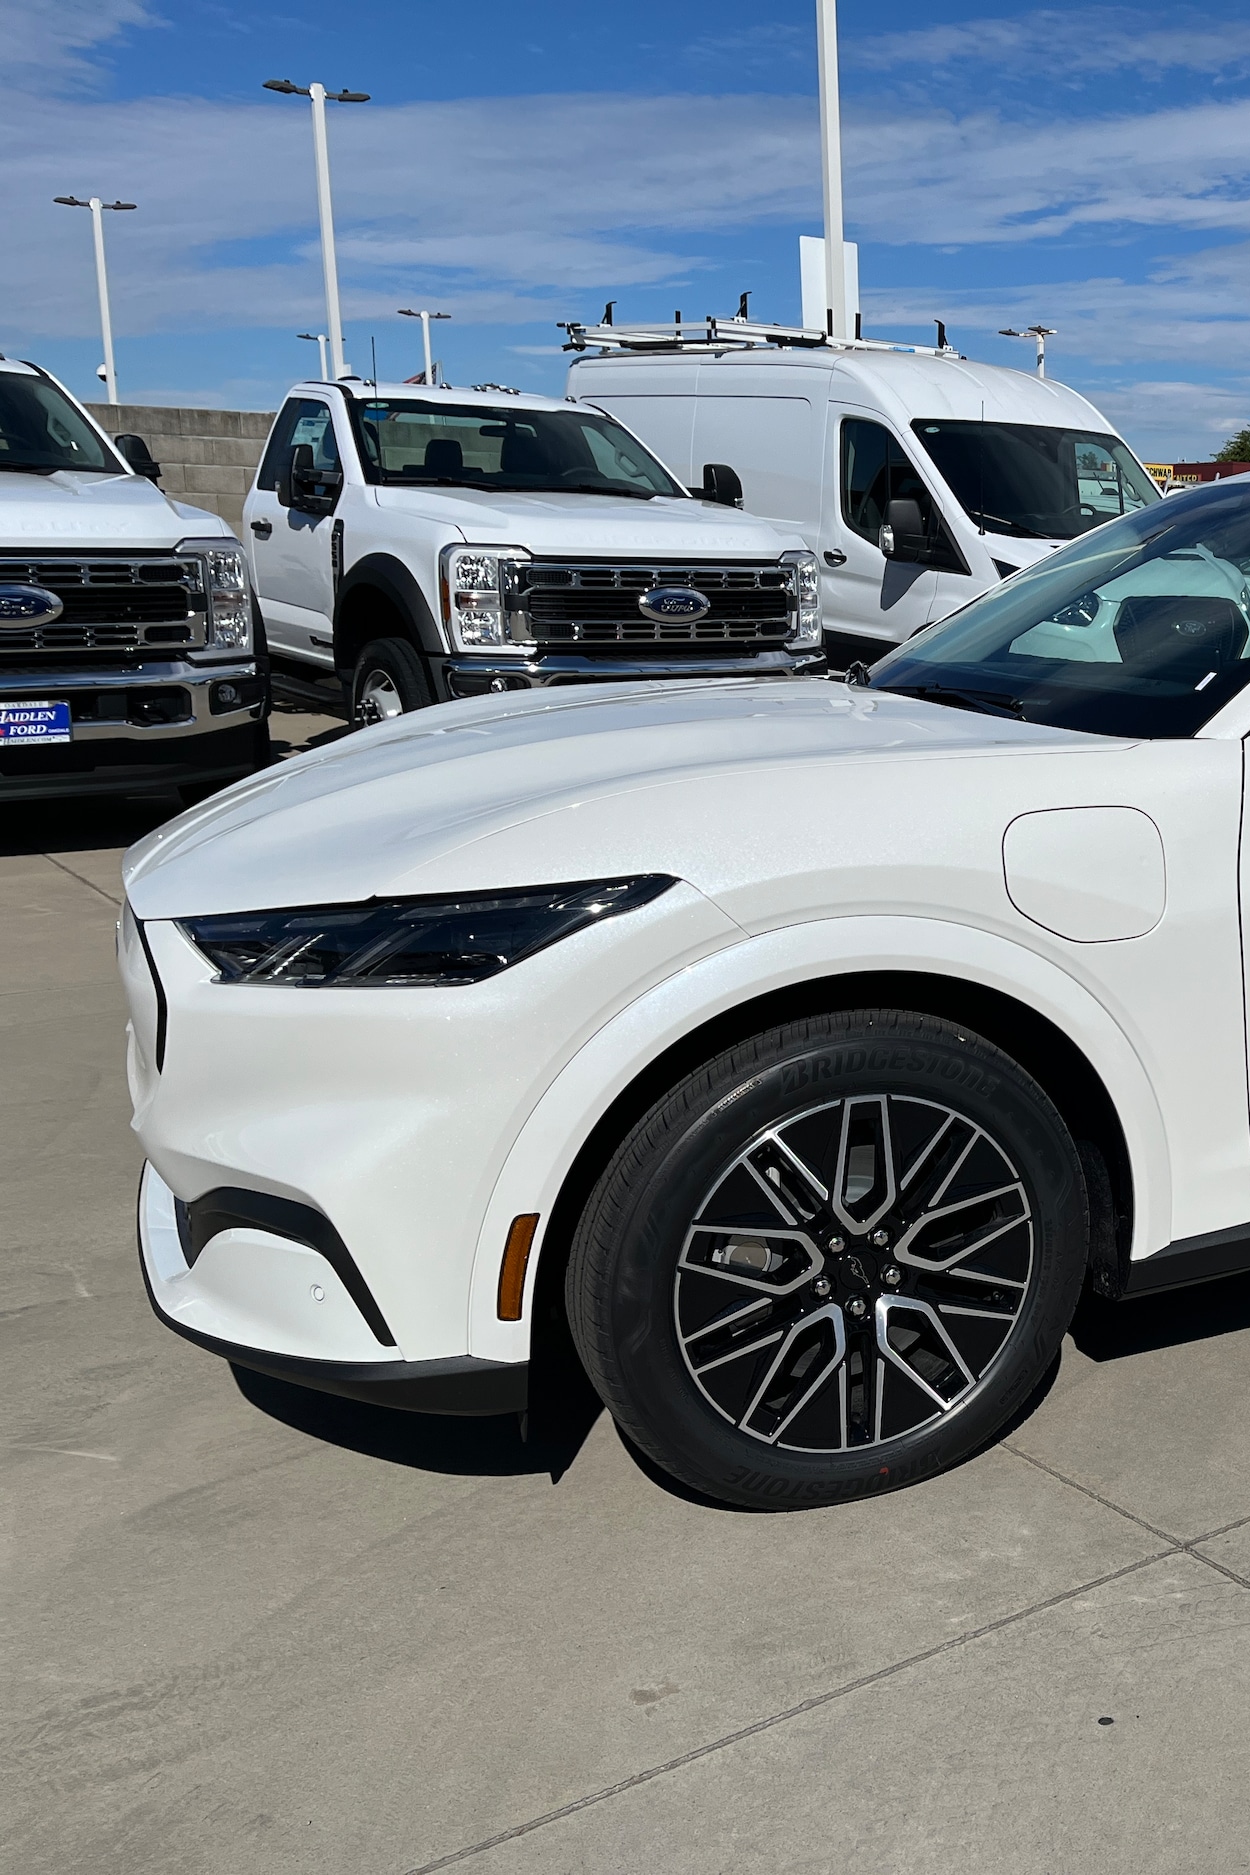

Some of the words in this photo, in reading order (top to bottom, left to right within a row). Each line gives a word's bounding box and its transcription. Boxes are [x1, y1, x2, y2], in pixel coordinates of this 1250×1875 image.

[9, 724, 47, 735] FORD
[782, 1046, 1000, 1098] BRIDGESTONE
[724, 1446, 942, 1500] BRIDGESTONE
